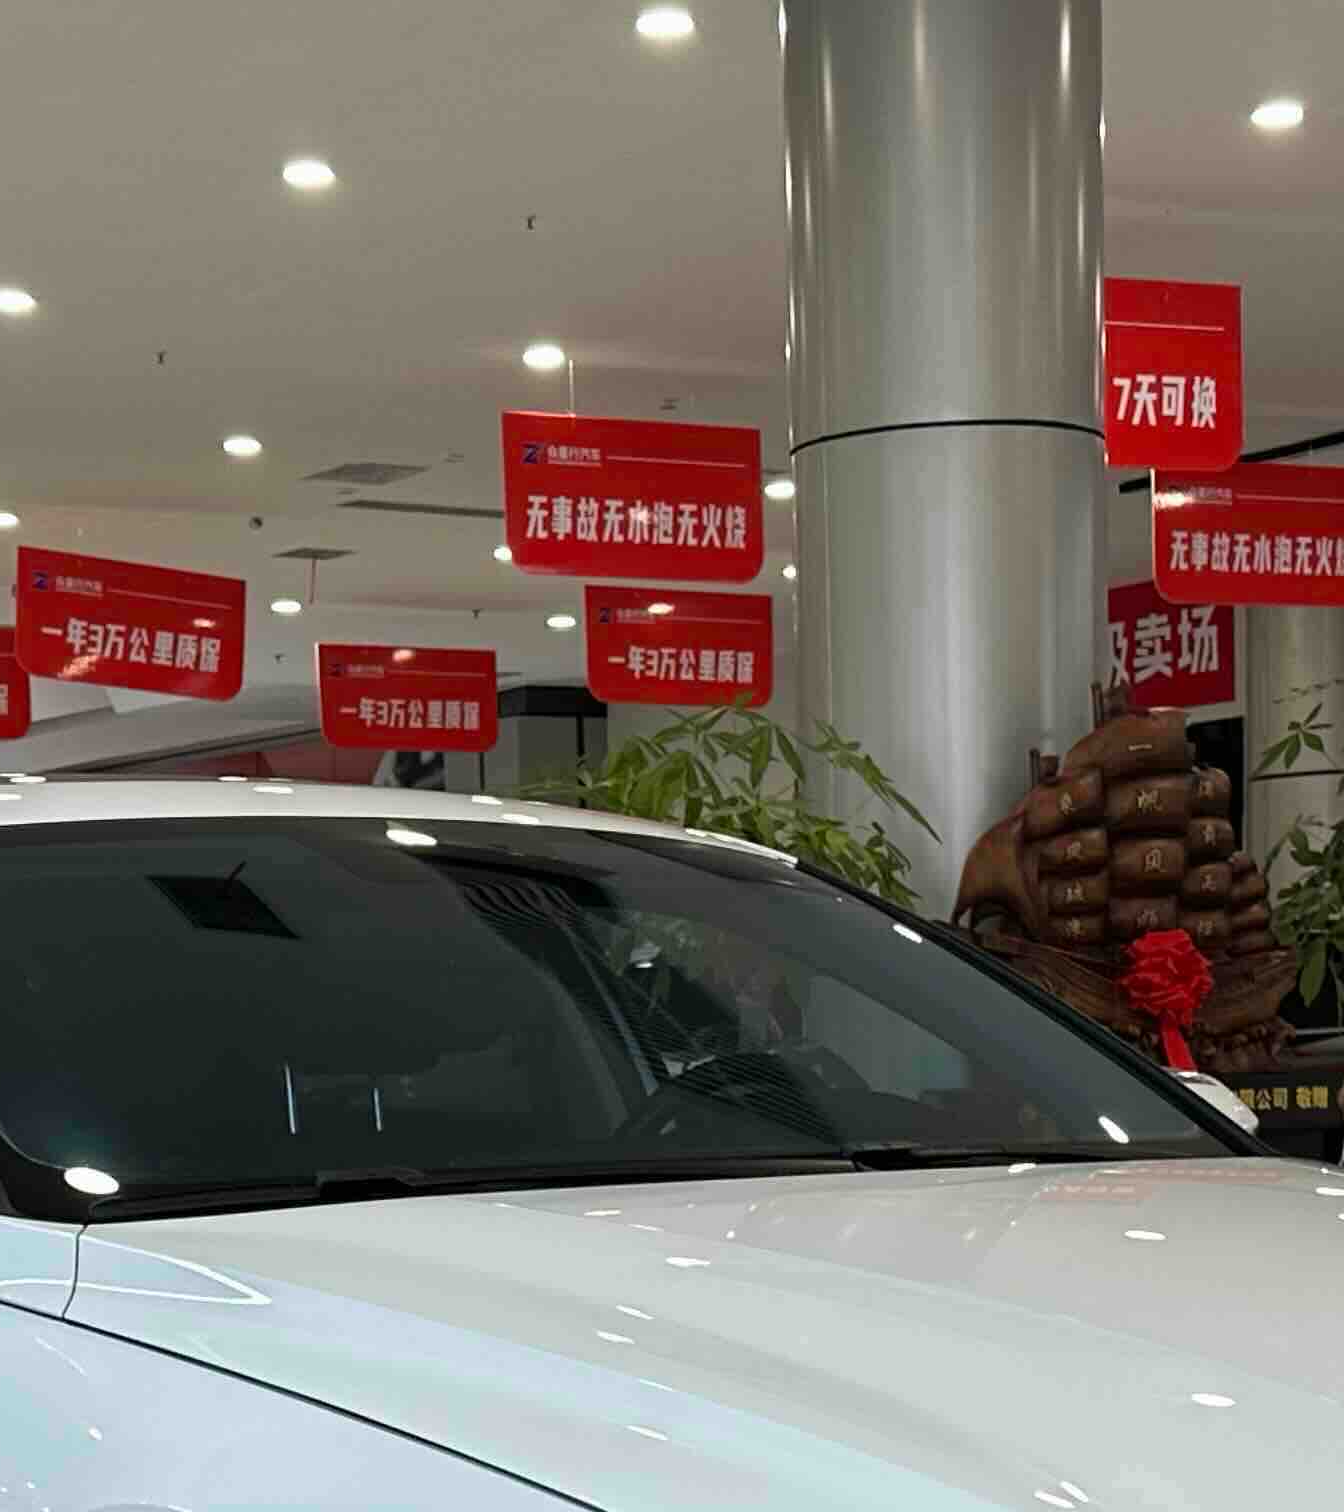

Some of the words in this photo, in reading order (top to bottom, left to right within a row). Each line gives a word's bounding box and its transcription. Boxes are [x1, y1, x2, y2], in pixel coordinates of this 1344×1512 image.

[1113, 374, 1217, 429] 7天可换
[526, 495, 747, 549] 无事故无水泡无火烧
[41, 617, 221, 673] 一年3万公里质保
[607, 645, 754, 684] 一年3万公里质保
[339, 697, 481, 731] 一年3万公里质保
